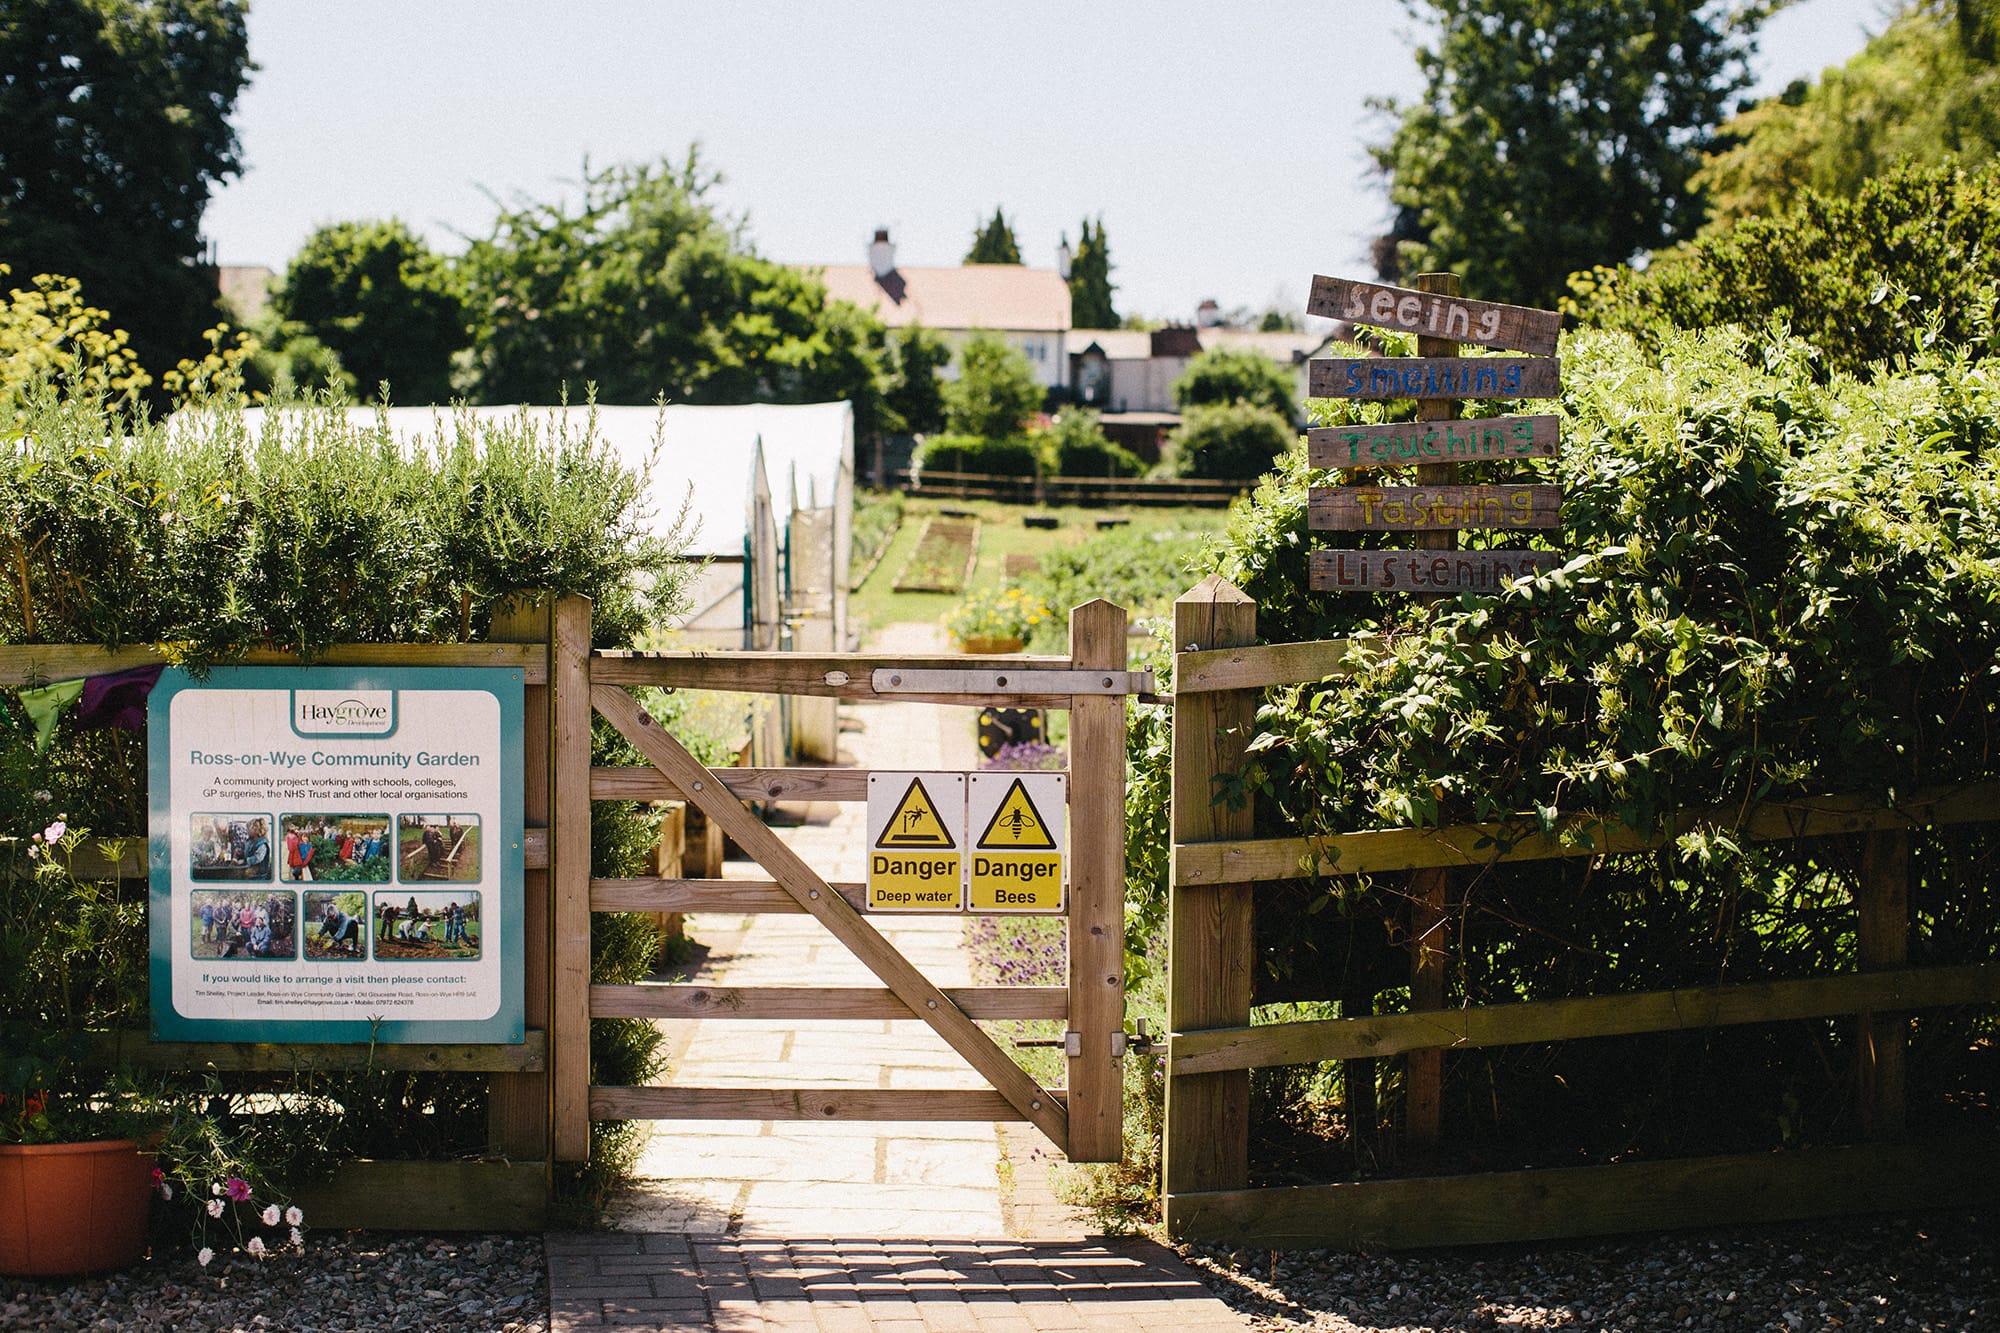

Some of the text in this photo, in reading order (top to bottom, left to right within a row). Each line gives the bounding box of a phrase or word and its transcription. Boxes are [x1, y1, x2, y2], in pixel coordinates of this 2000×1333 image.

[1343, 284, 1501, 341] Seeing
[1345, 362, 1521, 394] Smelling
[1339, 421, 1534, 463] Touching
[1355, 490, 1533, 526] Tasting
[302, 704, 386, 725] Haygrove
[190, 750, 480, 769] Ross-on-Wye Community Garden
[214, 777, 456, 788] A community project working with schools, colleges,
[203, 789, 468, 800] GP surgeries, the NHS Trust and other local organisations
[873, 856, 957, 880] Danger
[974, 858, 1058, 882] Danger
[876, 890, 953, 904] Deep water
[995, 890, 1037, 904] Bees
[203, 974, 209, 982] If
[211, 976, 229, 985] you
[232, 975, 261, 983] would
[263, 975, 280, 983] like
[283, 975, 293, 983] to
[295, 976, 334, 985] arrange
[345, 975, 364, 984] visit
[367, 976, 389, 984] then
[391, 975, 424, 985] please
[426, 976, 467, 984] contact:
